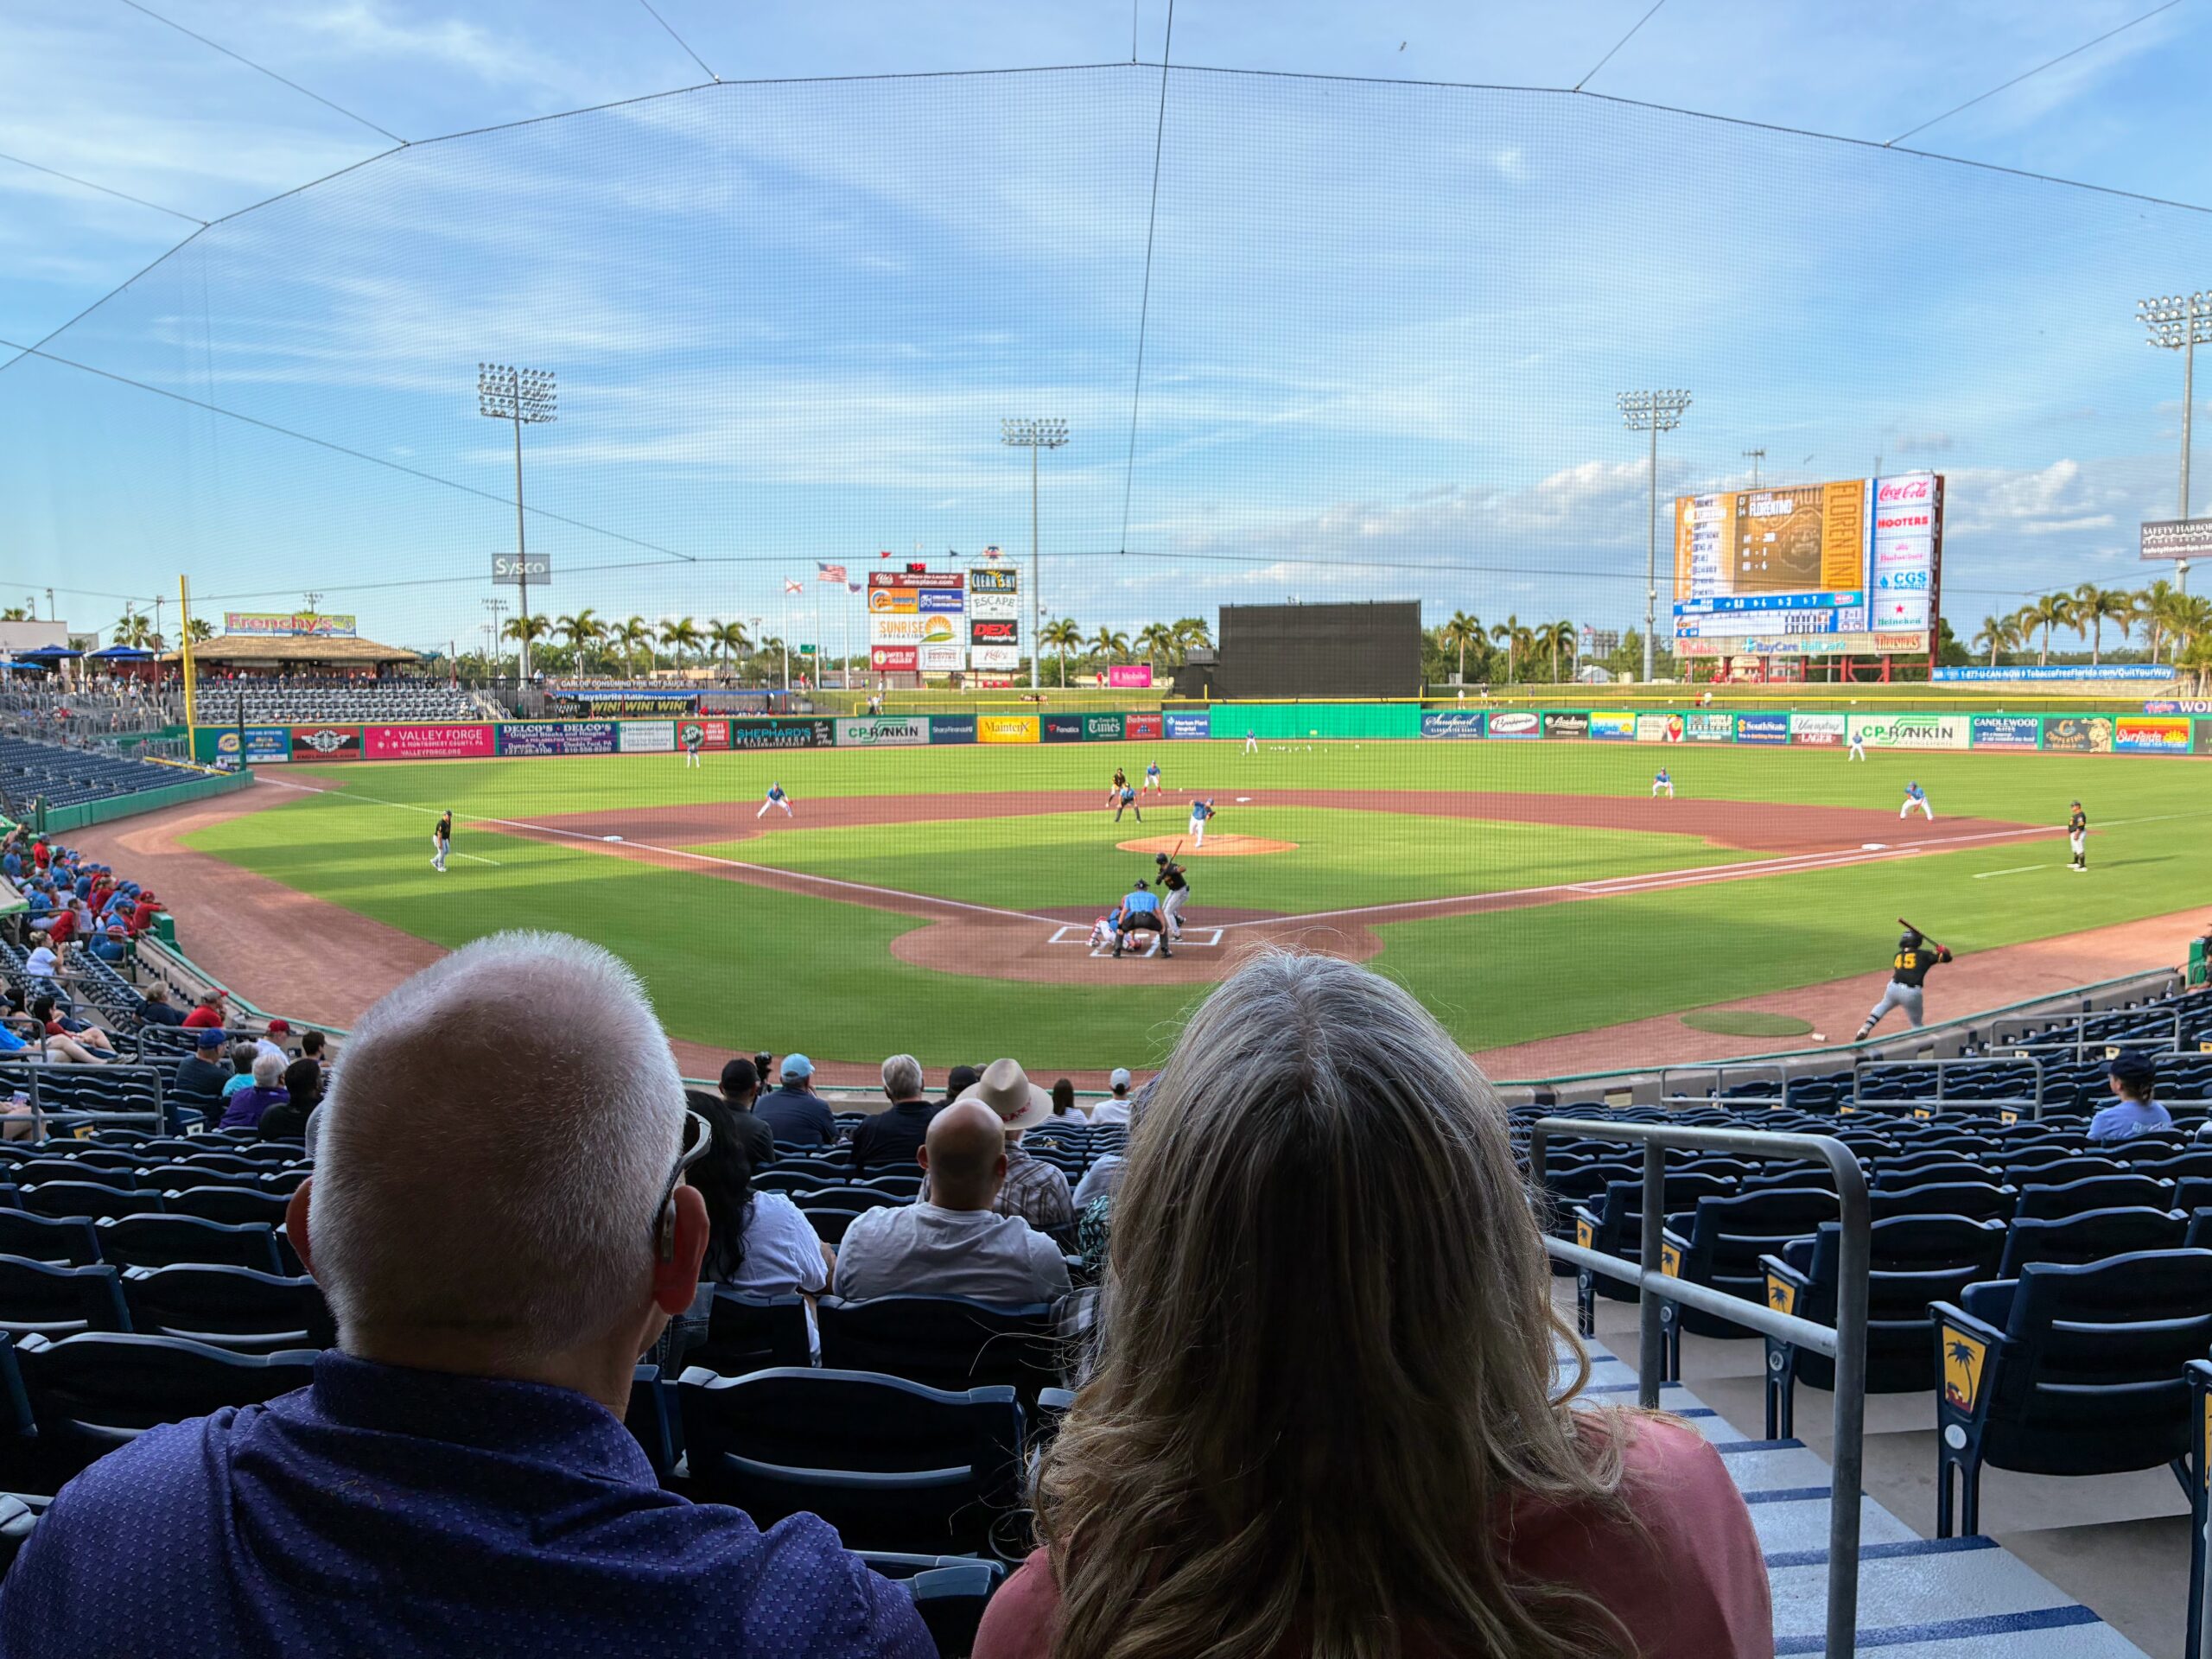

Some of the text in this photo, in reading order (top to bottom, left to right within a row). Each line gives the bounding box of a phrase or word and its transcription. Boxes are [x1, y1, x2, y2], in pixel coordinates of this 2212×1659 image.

[1750, 499, 1792, 518] FLORENTINO
[1878, 517, 1928, 529] HOOTERS
[1827, 484, 1858, 589] FLORENTINO
[496, 558, 544, 578] Sysco
[1894, 571, 1926, 583] CGS
[973, 596, 1015, 607] ESCAPE
[228, 613, 333, 633] Frenchy's
[880, 621, 925, 633] SUNRISE
[973, 624, 1013, 636] DEX
[1756, 640, 1847, 652] BayCare Ballpark
[591, 701, 622, 711] WIN!
[625, 701, 654, 711] WIN!
[658, 701, 688, 711] WIN!
[1127, 715, 1160, 723] Budweiser
[1974, 718, 2038, 727] CANDLEWOOD
[503, 723, 612, 734] DELCO'S DELCO'S
[1089, 719, 1121, 734] Times
[1746, 721, 1786, 731] SouthState
[1862, 726, 1885, 737] CP
[398, 728, 482, 741] VALLEY FORGE
[737, 728, 811, 739] SHEPHARD'S
[849, 728, 868, 737] CP
[1801, 734, 1834, 743] LAGER
[2116, 728, 2163, 743] Surfside
[1894, 952, 1916, 969] 45
